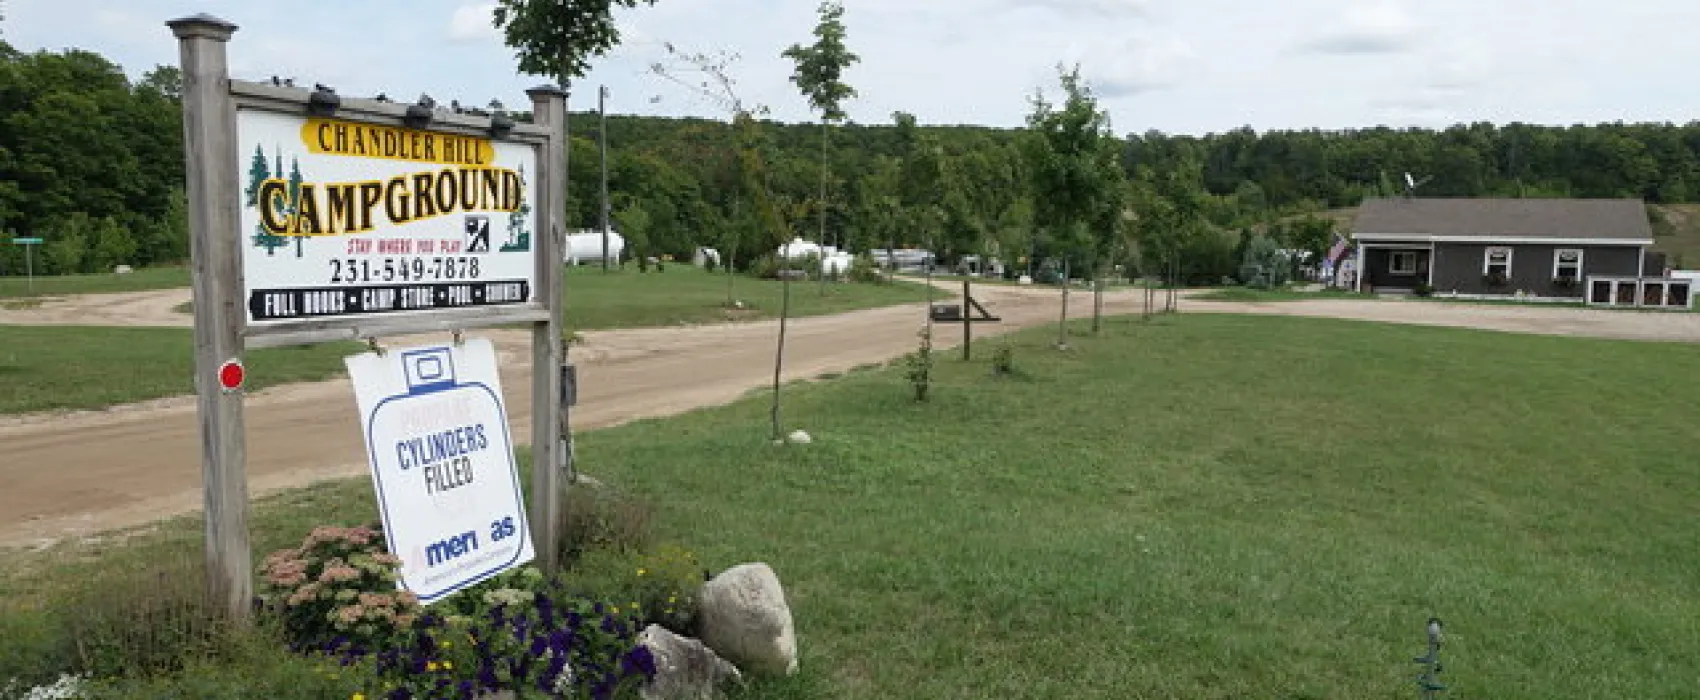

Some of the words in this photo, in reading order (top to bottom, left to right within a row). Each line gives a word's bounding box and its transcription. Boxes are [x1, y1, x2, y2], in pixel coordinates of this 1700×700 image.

[318, 123, 436, 162] CHANDLER
[443, 136, 484, 165] HILL
[259, 168, 522, 236] CAMPGROUND
[348, 238, 372, 254] STAY
[376, 238, 412, 254] WHERE
[416, 239, 434, 254] YOU
[440, 239, 461, 254] PLAY
[329, 257, 480, 282] 231-549-7878
[362, 288, 396, 310] CAMP
[448, 284, 472, 305] POOL
[396, 423, 488, 470] CYLINDERS
[424, 456, 474, 495] FILLED
